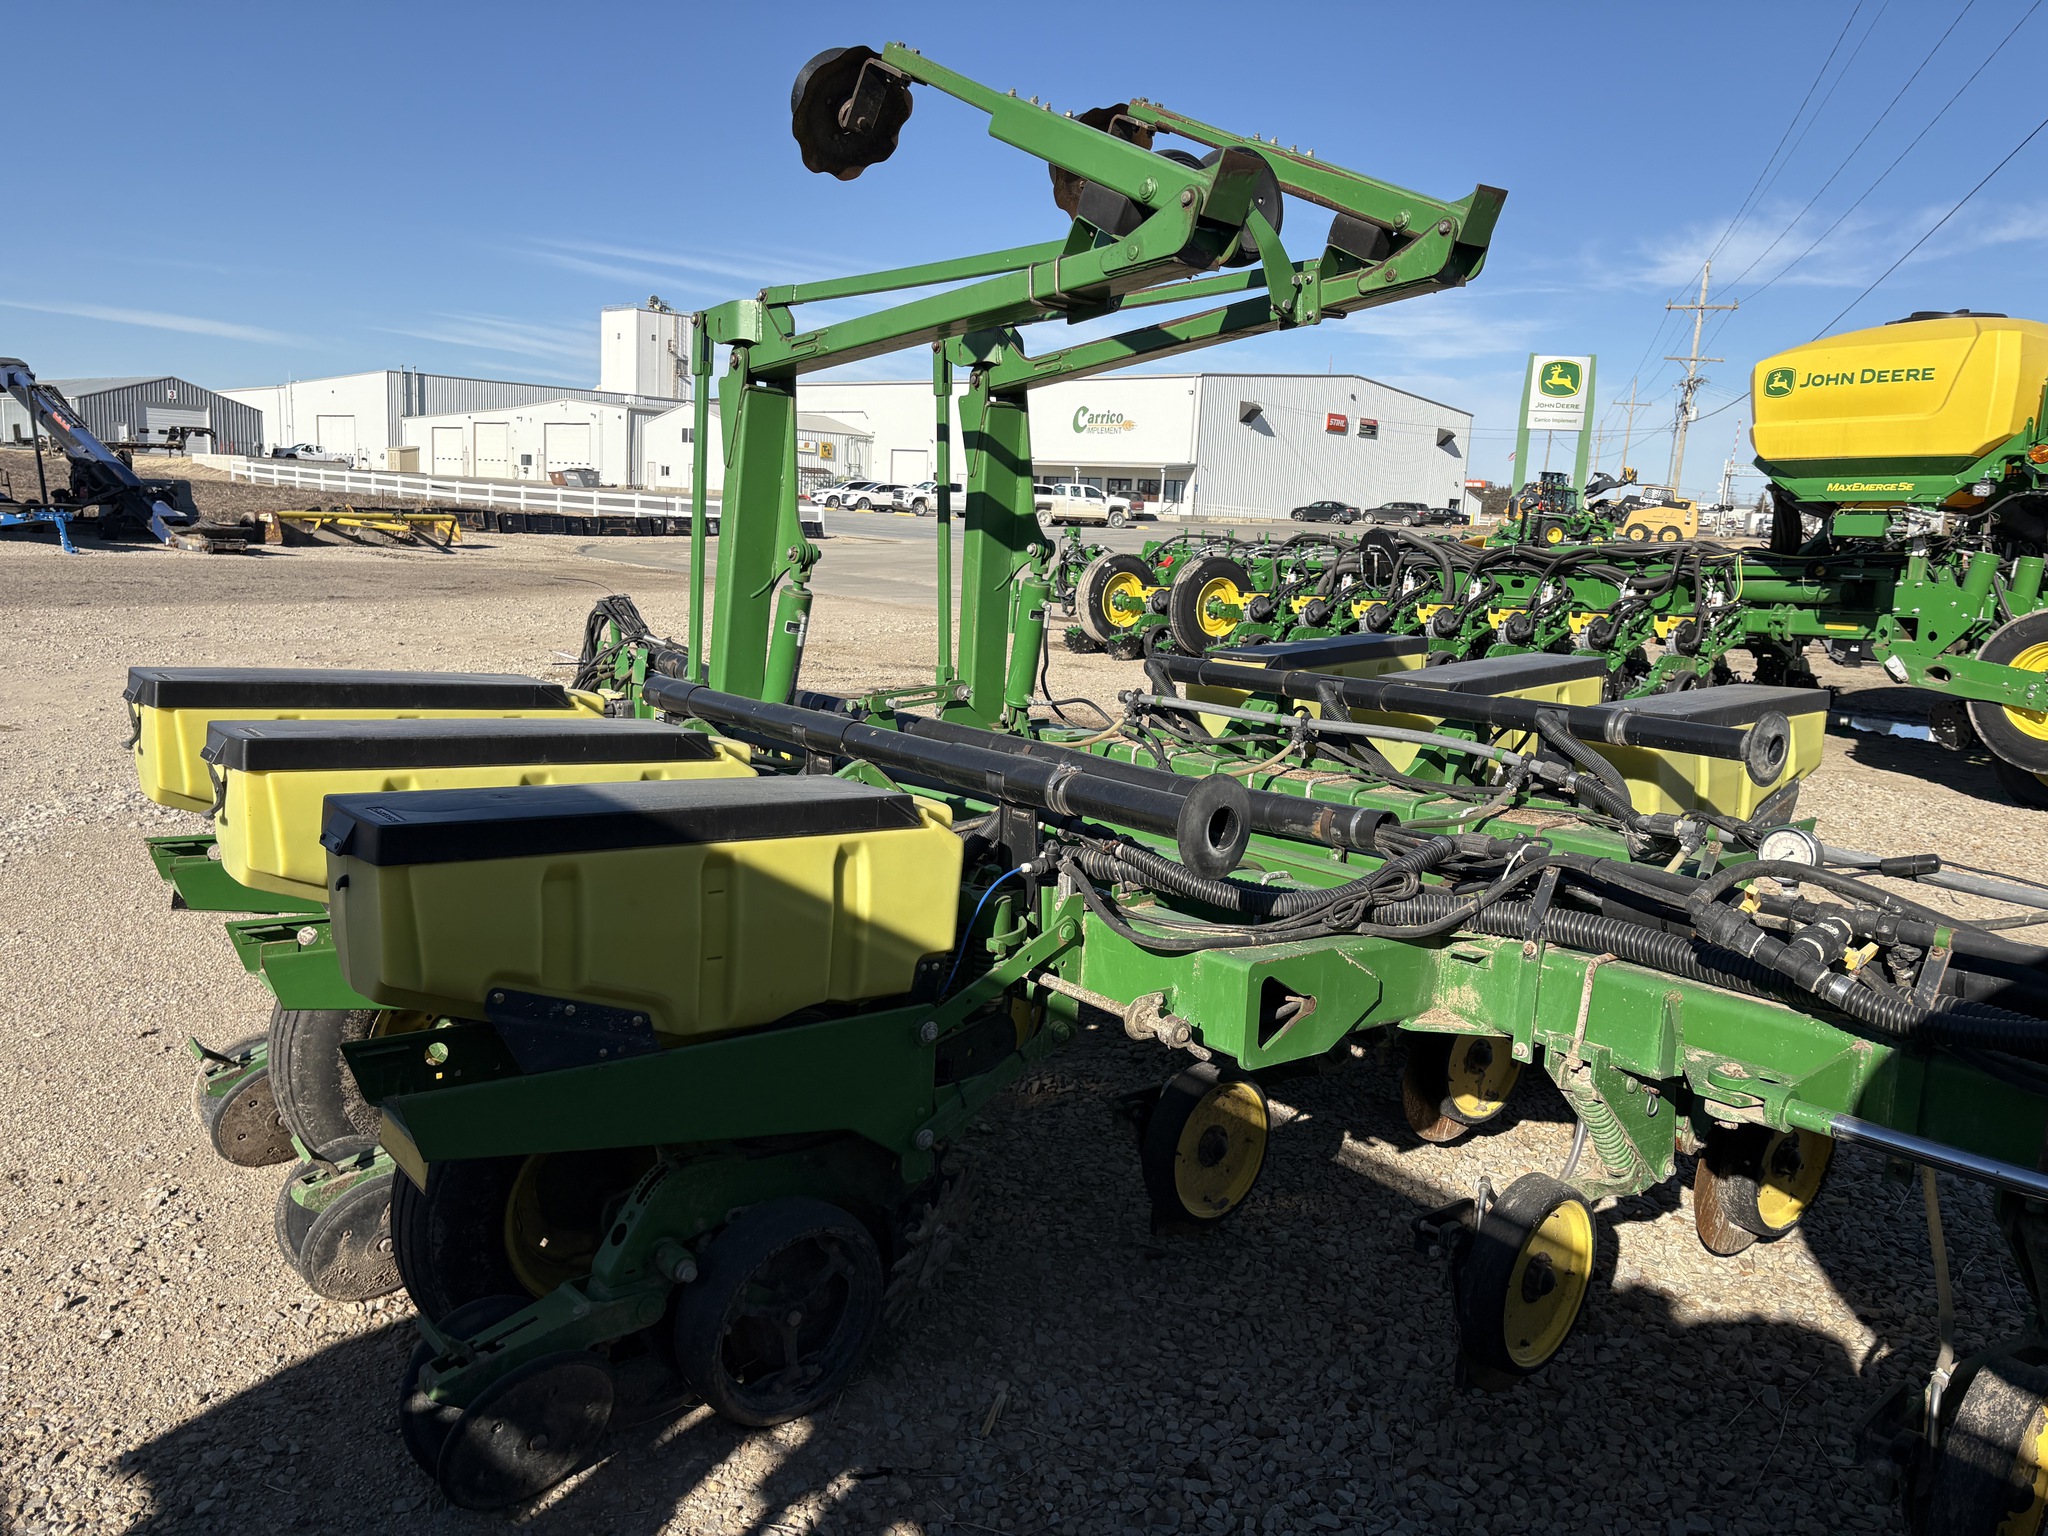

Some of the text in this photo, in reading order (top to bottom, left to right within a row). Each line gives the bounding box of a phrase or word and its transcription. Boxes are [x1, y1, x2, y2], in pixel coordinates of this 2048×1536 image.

[1800, 367, 1936, 388] JOHN DEERE
[1073, 406, 1123, 434] Carrico
[1329, 418, 1346, 427] STIHL
[1086, 426, 1122, 434] IMPLEMENT
